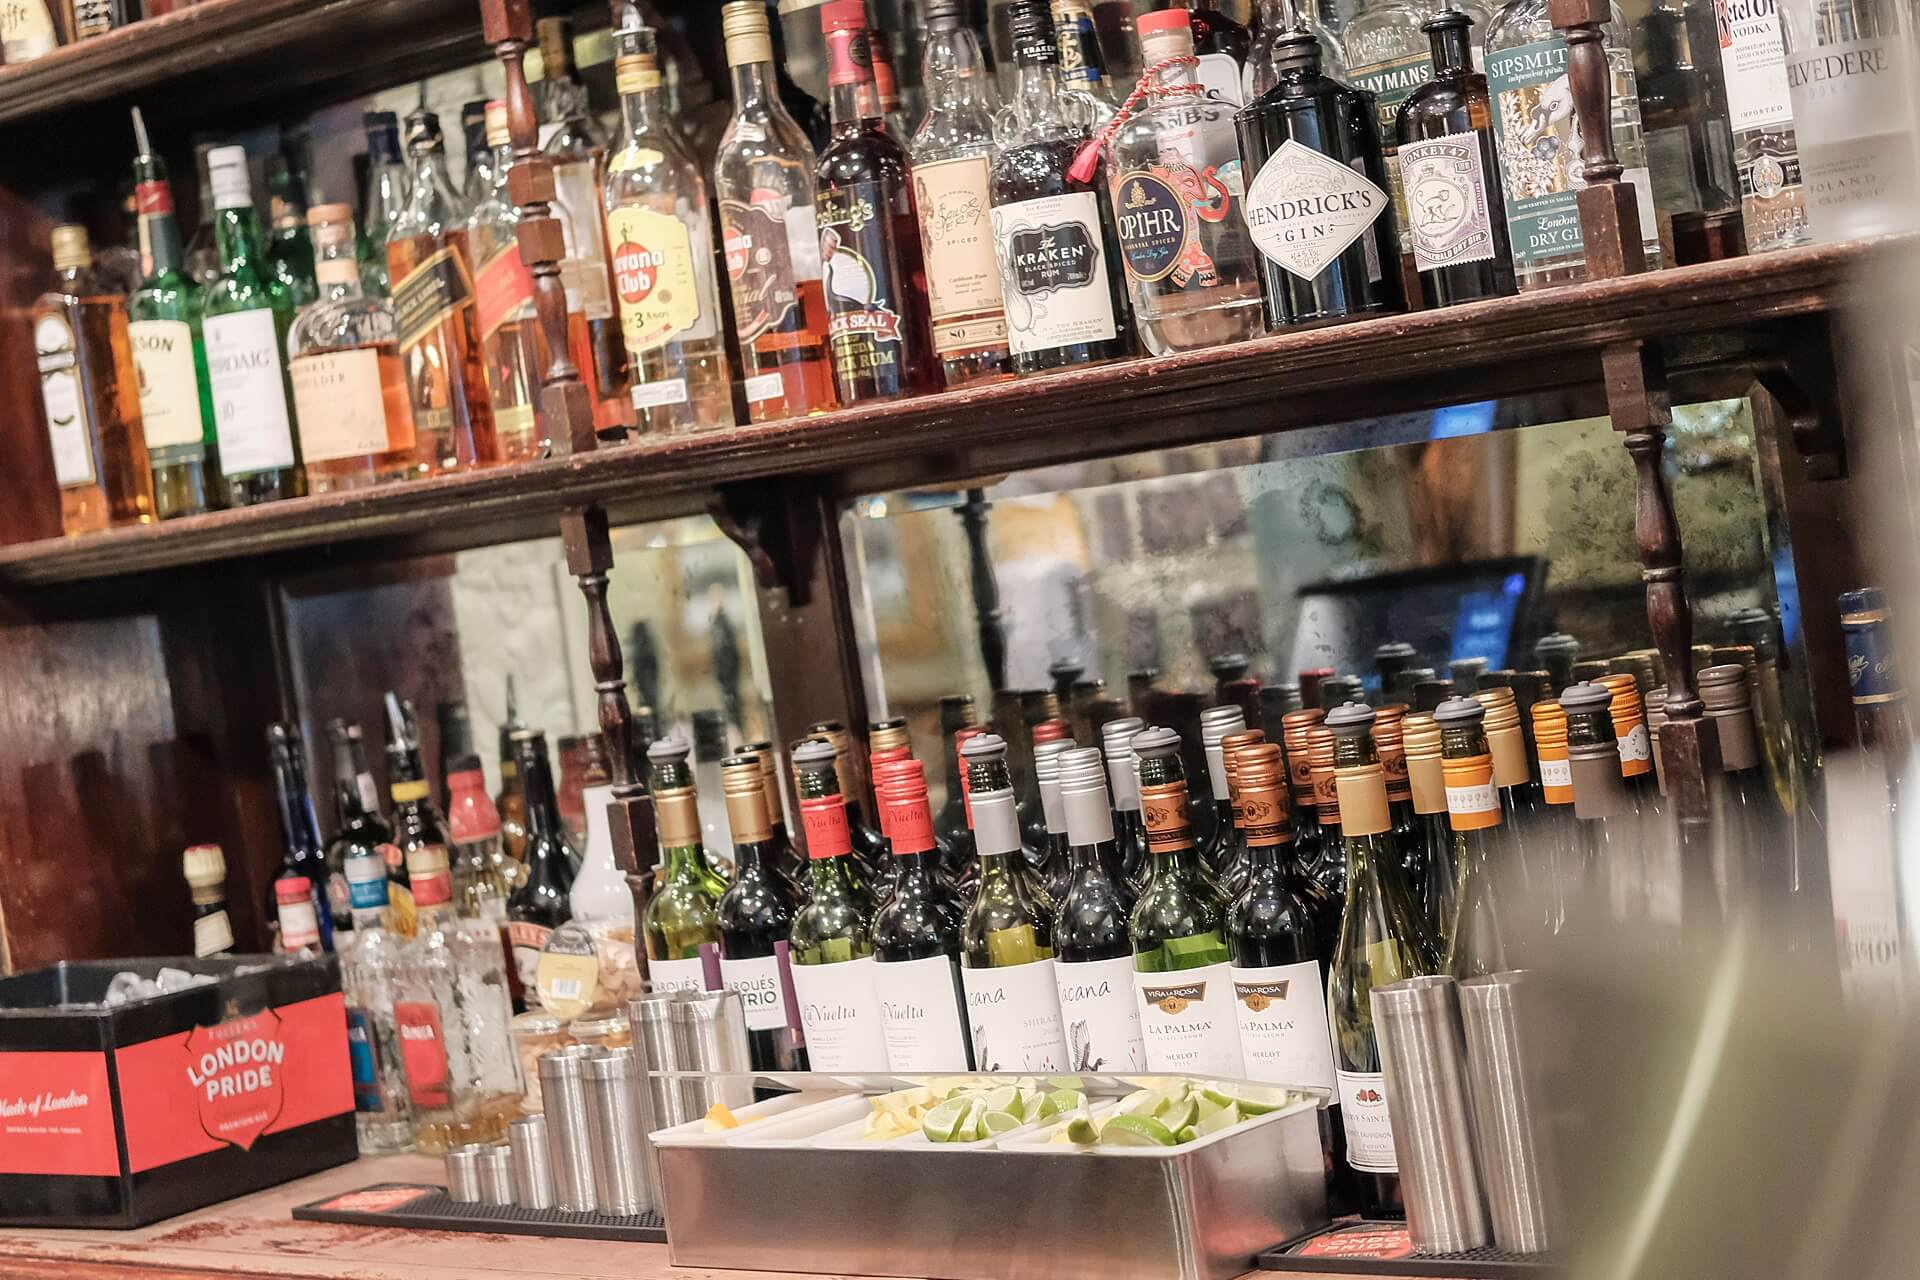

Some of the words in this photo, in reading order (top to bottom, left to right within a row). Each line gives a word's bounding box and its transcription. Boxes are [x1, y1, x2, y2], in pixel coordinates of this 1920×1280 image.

[1733, 24, 1772, 38] VODKA
[1491, 47, 1568, 78] SIPSMIT
[1787, 48, 1889, 89] ELVEDERE
[1383, 105, 1399, 118] TO
[1740, 105, 1783, 119] IMPORTED
[1450, 148, 1467, 156] 47
[1248, 190, 1372, 228] HENDRICK'S
[1118, 208, 1181, 240] OPIHR
[1537, 215, 1577, 230] London
[1284, 225, 1325, 242] GIN
[1529, 231, 1558, 248] DRY
[1561, 227, 1580, 241] GI
[1016, 246, 1084, 267] KRAKEN
[1453, 241, 1468, 256] DRY
[1024, 263, 1046, 273] BLACK
[1049, 259, 1077, 268] SPICED
[1041, 269, 1060, 279] RUM
[634, 312, 645, 329] 3
[849, 313, 887, 329] SEAL
[136, 337, 174, 353] SON
[860, 350, 895, 368] RUM
[741, 990, 778, 1007] TRIO
[968, 987, 1007, 1007] cana
[1061, 980, 1112, 1003] acana
[1023, 1014, 1058, 1028] SHIRAZ
[1129, 1011, 1140, 1021] SH
[1148, 1024, 1162, 1034] LA
[187, 1038, 285, 1088] LONDON
[1165, 1051, 1200, 1061] MERLOT
[206, 1064, 273, 1103] PRIDE
[41, 1089, 89, 1112] London
[1324, 1241, 1401, 1252] PRIDE
